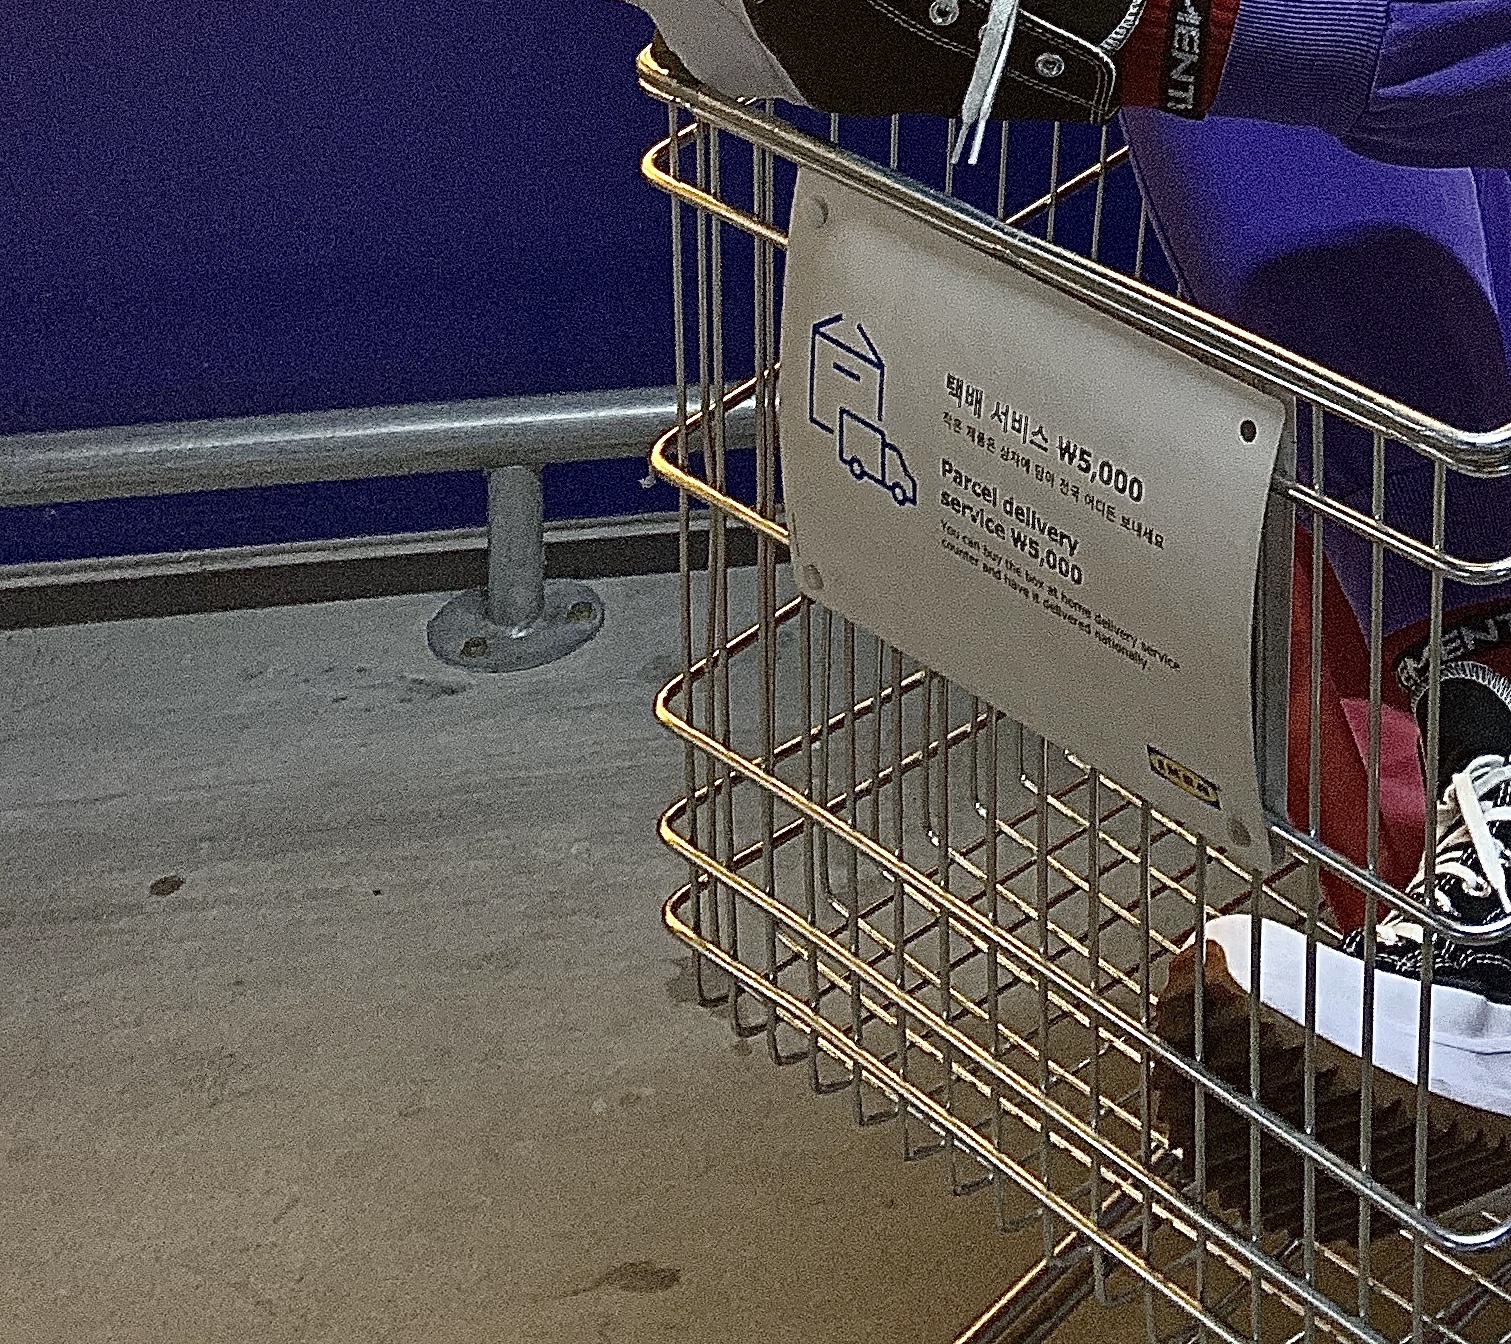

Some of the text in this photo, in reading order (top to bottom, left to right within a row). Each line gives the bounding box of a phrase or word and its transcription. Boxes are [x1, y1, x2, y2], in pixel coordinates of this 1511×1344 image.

[946, 372, 984, 419] 택배
[990, 401, 1048, 453] 서비스
[940, 490, 1006, 541] service
[941, 457, 1080, 557] Parcel delivery
[1084, 493, 1116, 522] 어디든
[1120, 515, 1164, 550] 보내세요
[940, 518, 960, 540] You
[961, 533, 981, 552] can
[983, 544, 1002, 566] buy
[1005, 558, 1022, 578] the
[1025, 569, 1045, 590] box
[1061, 590, 1092, 619] home
[1094, 614, 1138, 648] delivery
[1140, 640, 1181, 670] service
[940, 537, 979, 567] counter
[982, 562, 1002, 581] and
[1004, 573, 1030, 599] have
[1042, 598, 1092, 635] delivered
[1094, 630, 1149, 670] nationally
